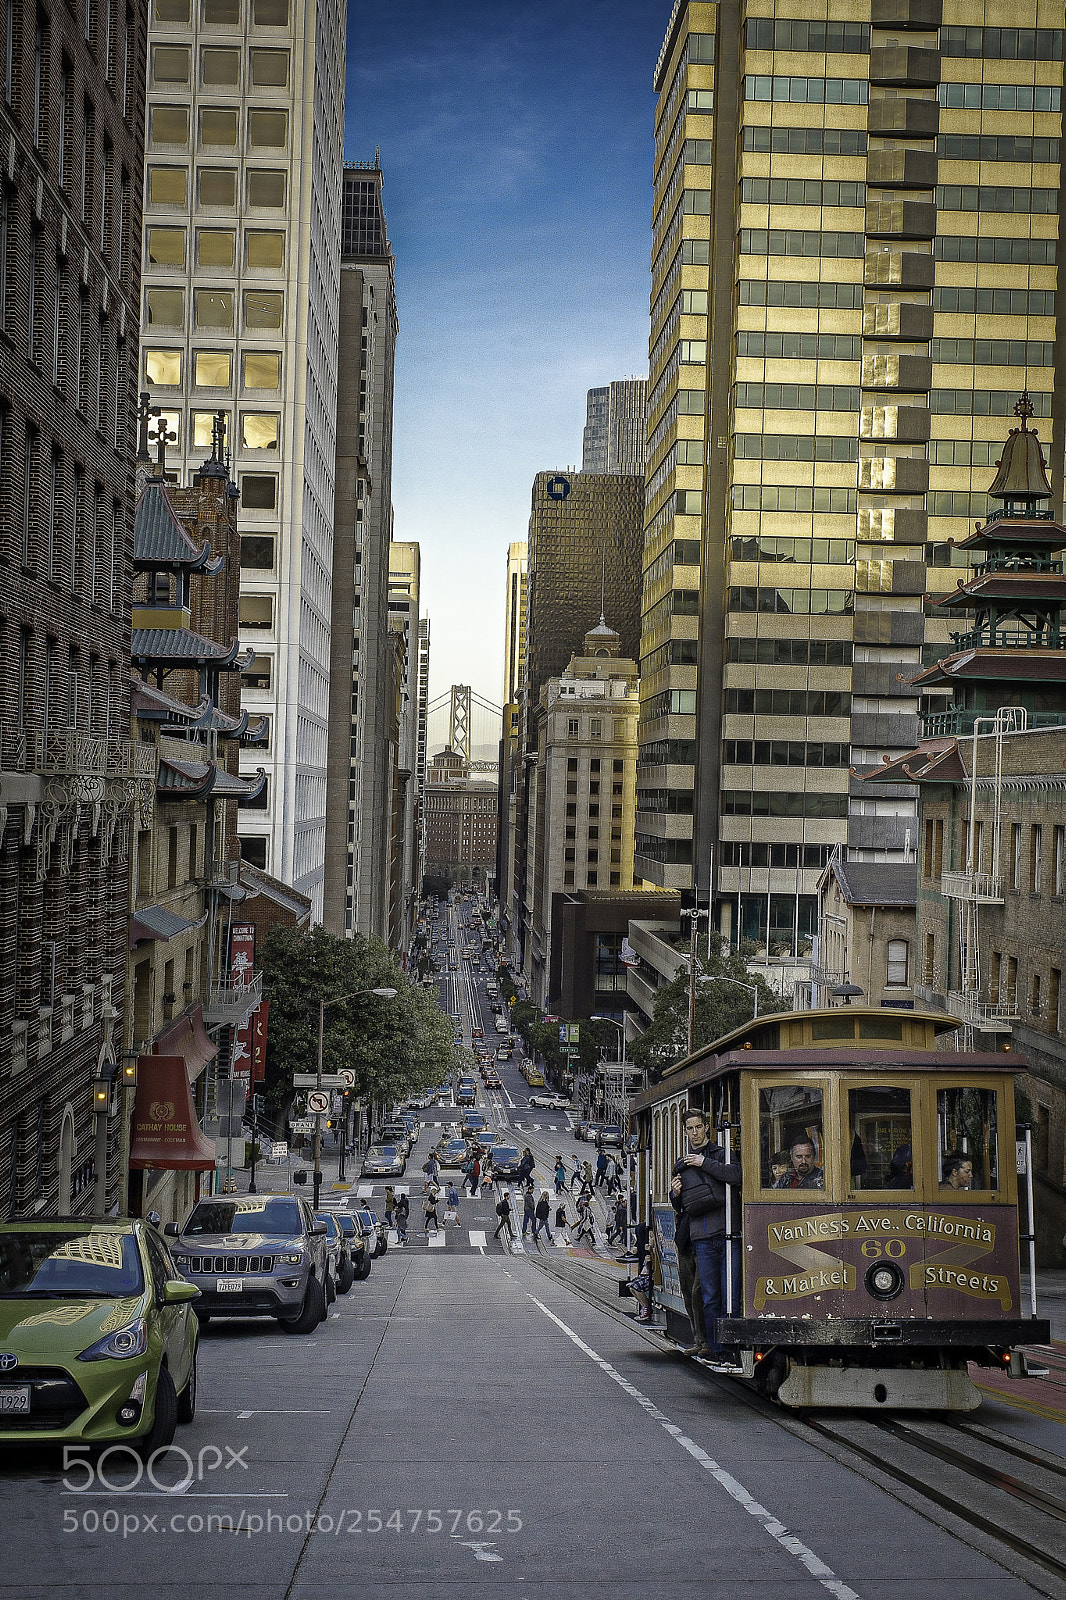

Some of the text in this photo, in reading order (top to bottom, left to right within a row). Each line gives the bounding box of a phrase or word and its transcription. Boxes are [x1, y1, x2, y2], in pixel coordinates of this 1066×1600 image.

[136, 1123, 188, 1132] CATHAY HOUSE
[772, 1224, 804, 1243] Van
[805, 1217, 849, 1237] Ness
[904, 1214, 993, 1243] California
[860, 1238, 907, 1258] 60
[765, 1266, 1000, 1295] & Market Streets
